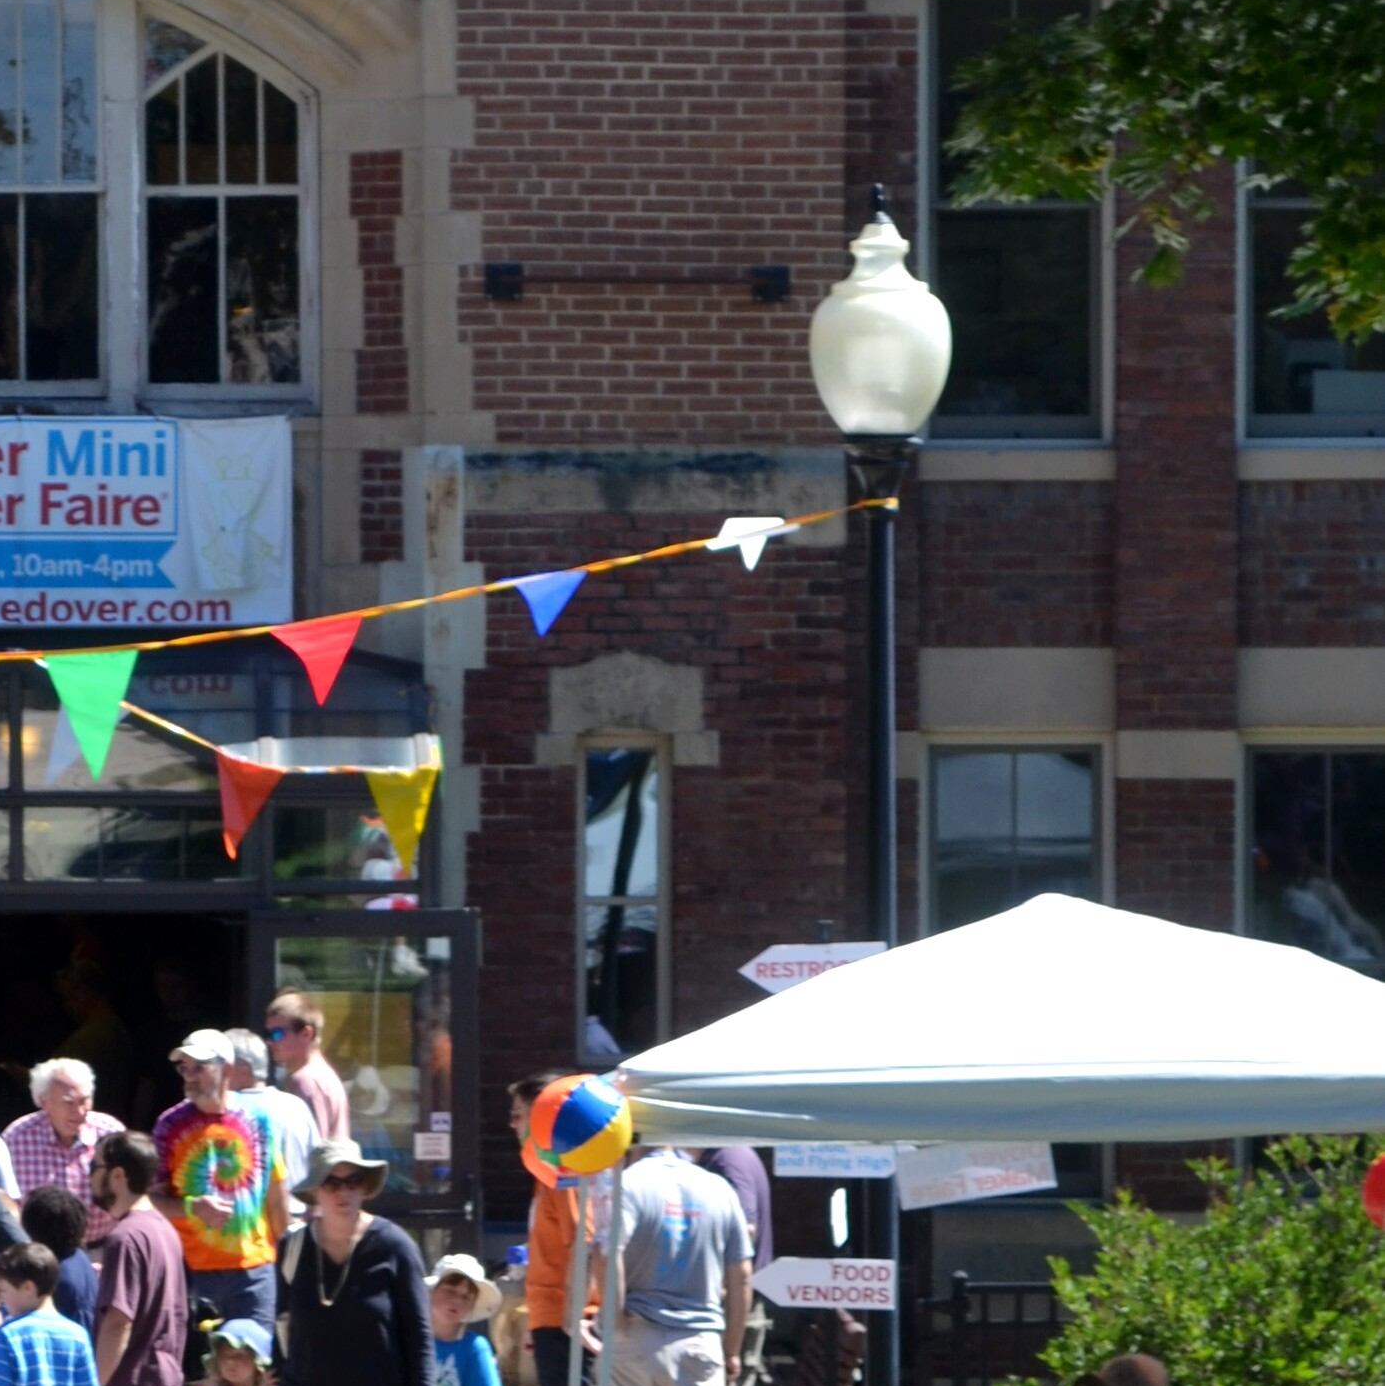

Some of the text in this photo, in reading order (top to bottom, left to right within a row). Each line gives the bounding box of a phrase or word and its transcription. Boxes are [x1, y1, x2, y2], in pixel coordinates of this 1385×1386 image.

[46, 428, 167, 477] Mini
[39, 482, 162, 527] Faire
[13, 553, 154, 580] 10am-4pm
[830, 1264, 890, 1282] FOOD
[787, 1285, 890, 1304] VENDORS
